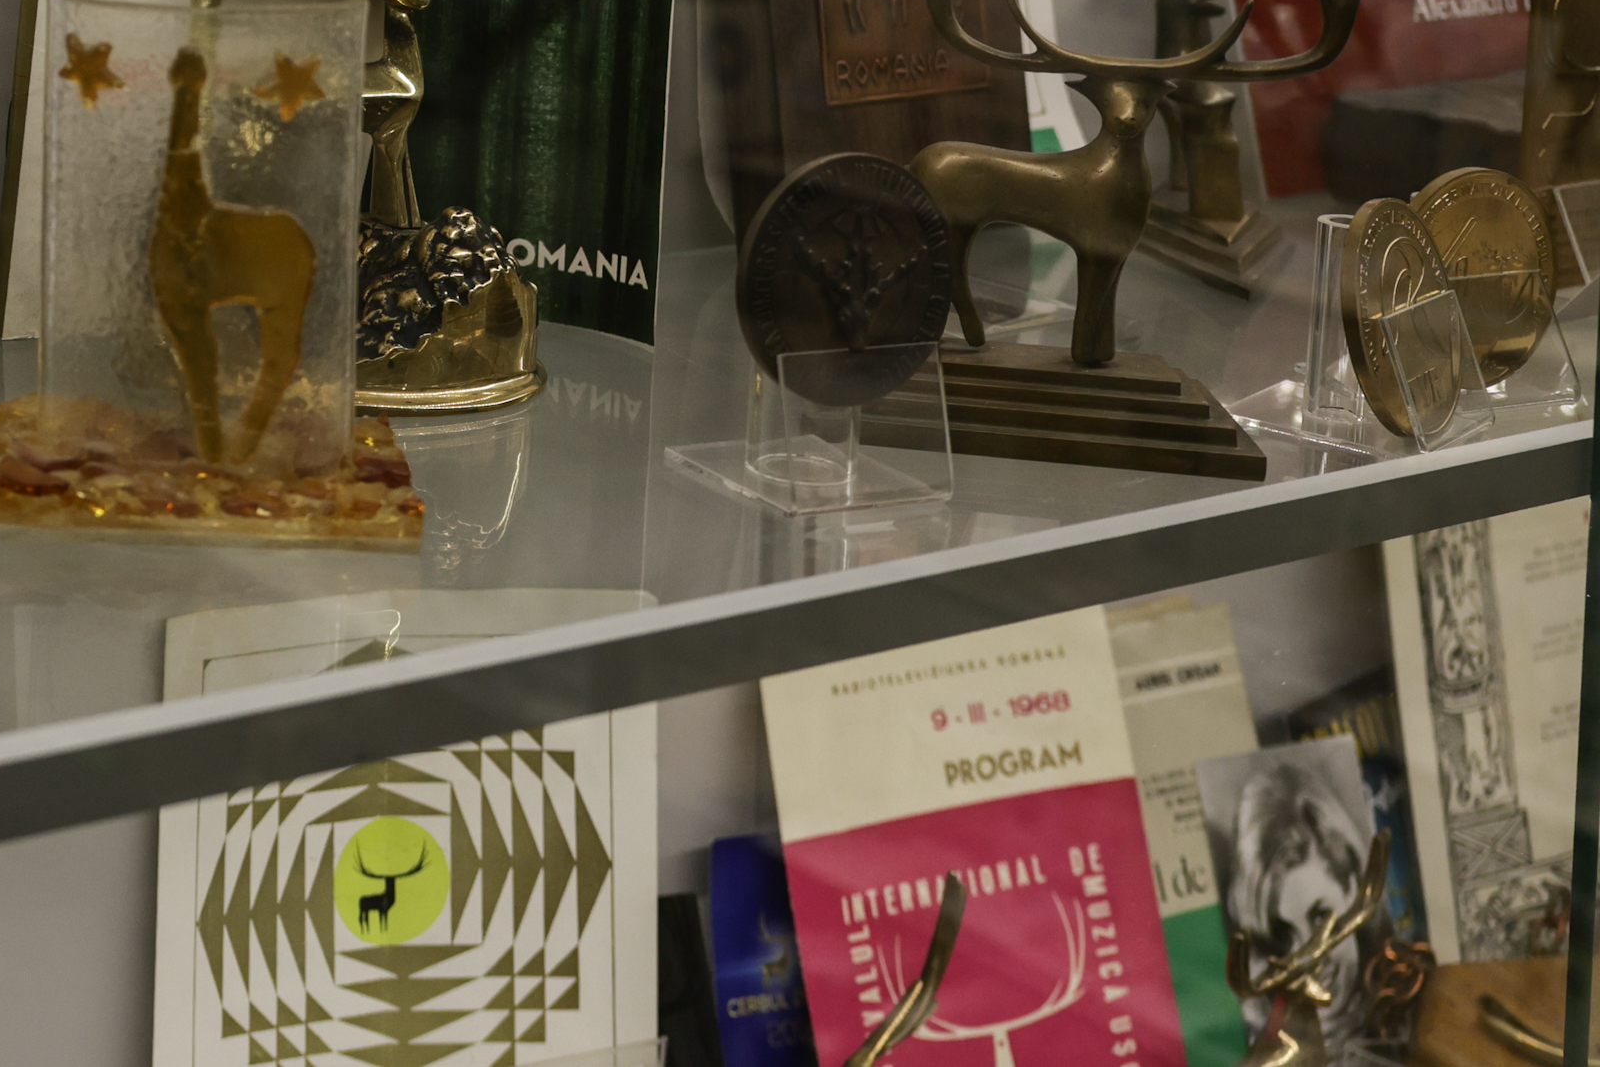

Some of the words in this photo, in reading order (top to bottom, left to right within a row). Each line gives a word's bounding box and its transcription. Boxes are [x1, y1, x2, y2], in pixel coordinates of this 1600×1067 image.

[506, 237, 649, 291] OMANIA
[930, 708, 948, 731] 9
[1008, 690, 1071, 718] 1968
[944, 740, 1083, 788] PROGRAM
